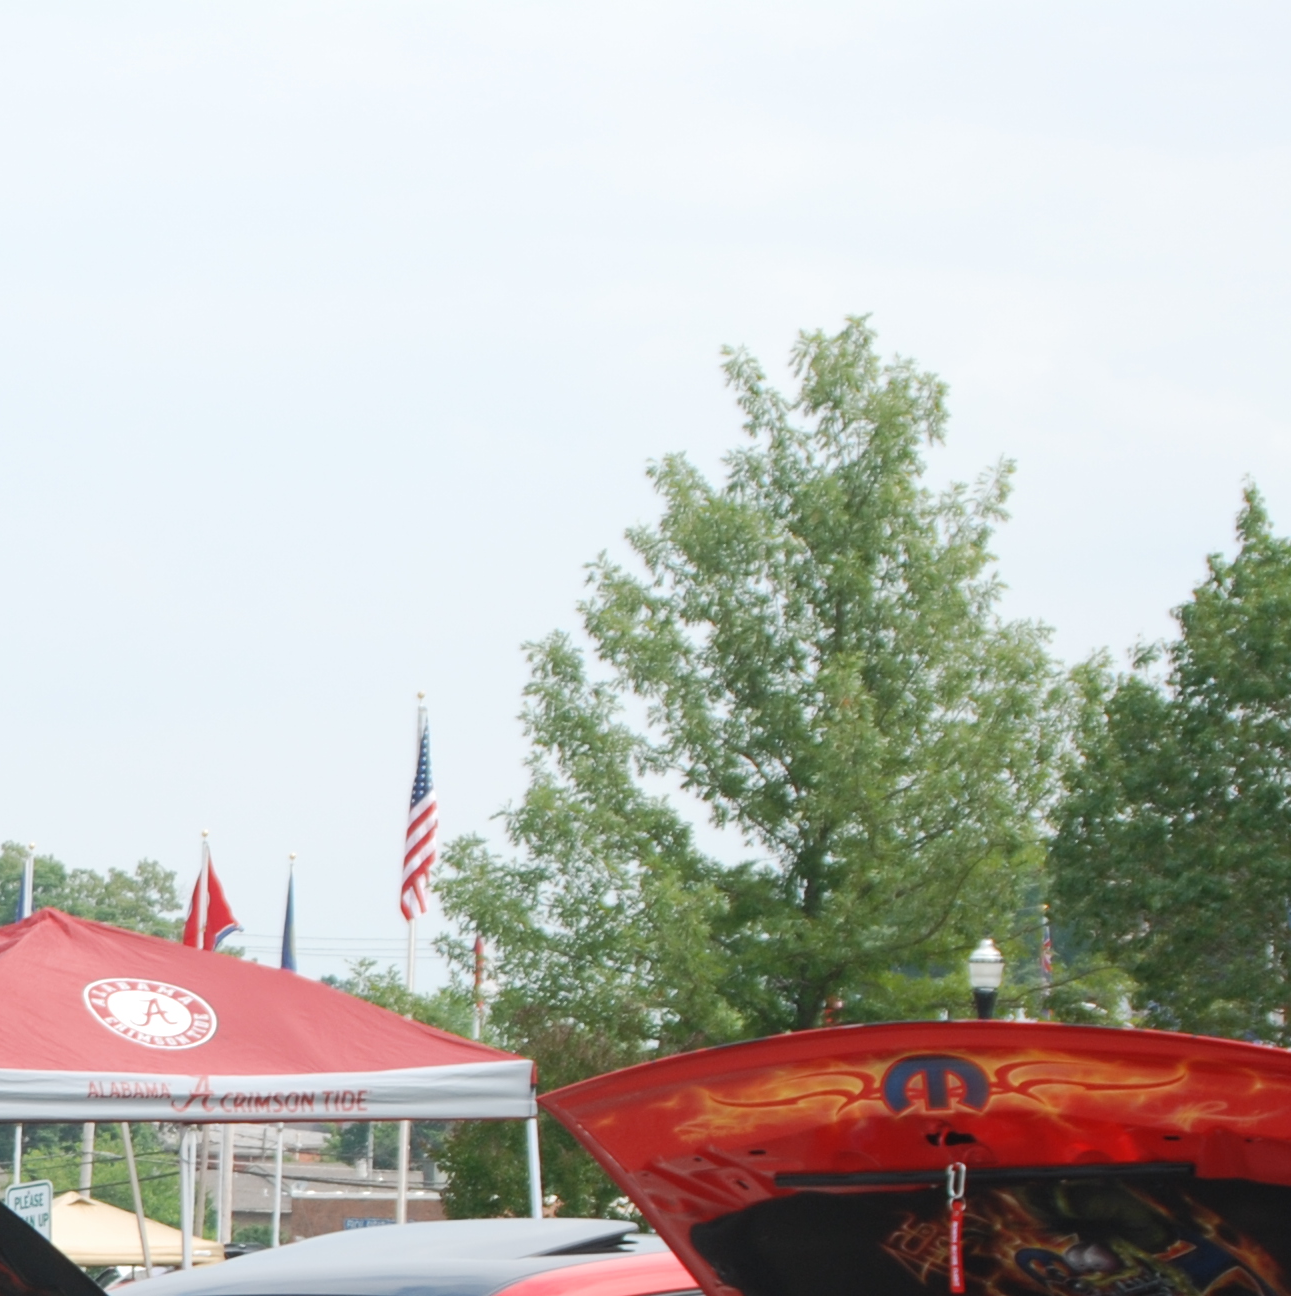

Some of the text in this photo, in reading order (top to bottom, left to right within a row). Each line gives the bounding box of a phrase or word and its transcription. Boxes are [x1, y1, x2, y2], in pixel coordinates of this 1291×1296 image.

[90, 981, 195, 1008] ALABAMA
[103, 1013, 211, 1046] CRIMSON TIDE
[87, 1080, 171, 1099] ALABAMA
[219, 1091, 315, 1113] CRIMSON
[323, 1089, 369, 1112] TIDE
[14, 1192, 44, 1211] PLEASE
[38, 1212, 49, 1228] UP
